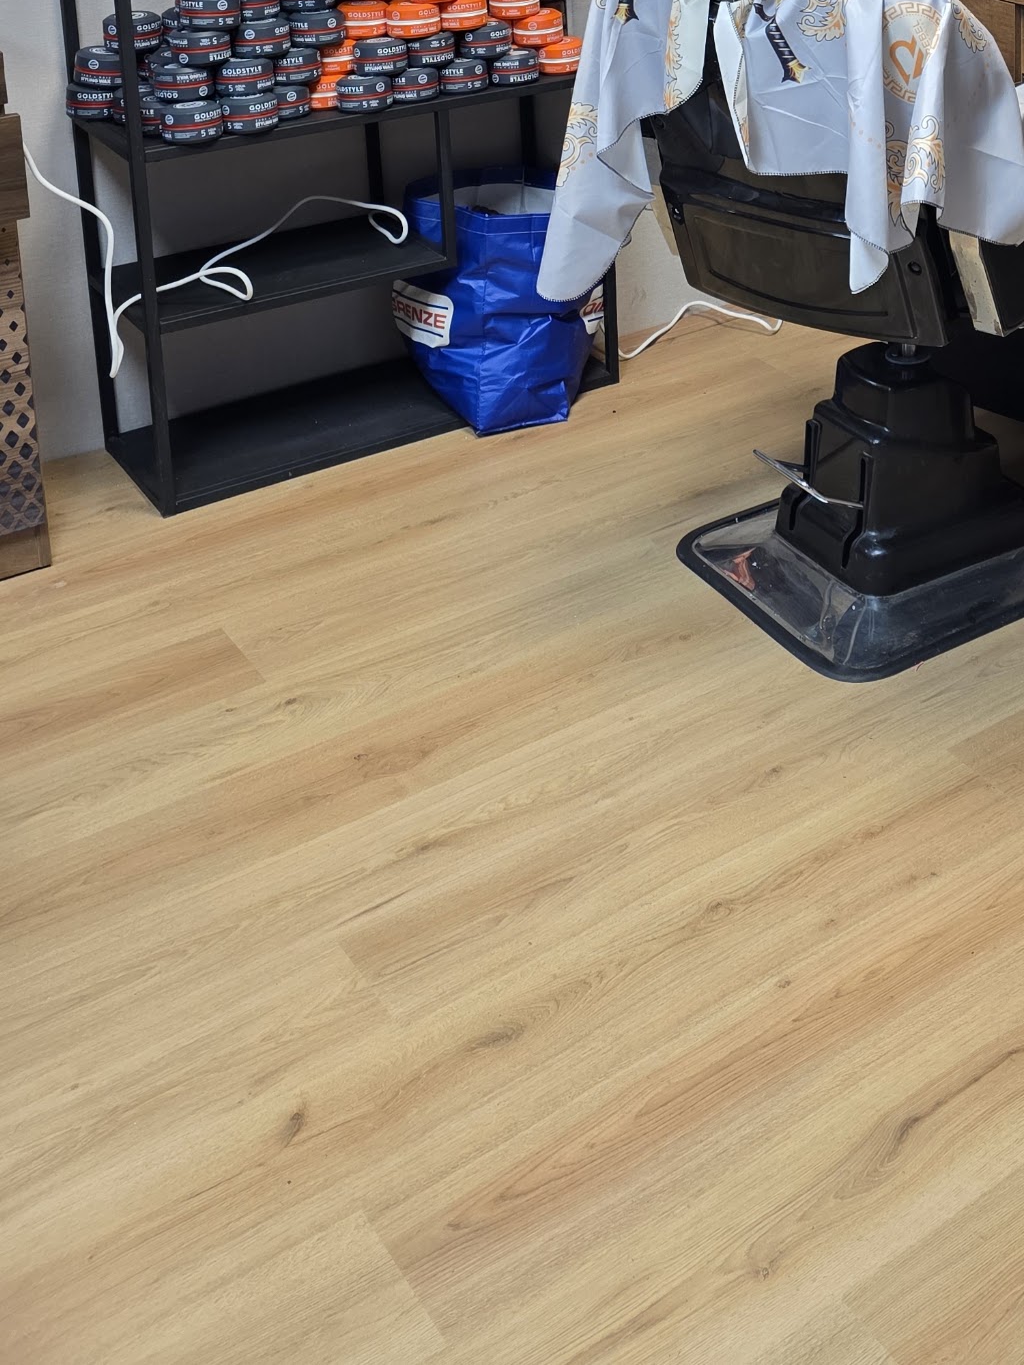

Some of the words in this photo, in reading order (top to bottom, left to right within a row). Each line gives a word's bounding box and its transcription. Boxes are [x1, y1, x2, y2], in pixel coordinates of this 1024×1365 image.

[222, 66, 262, 74] GOLDSTYLE
[314, 69, 318, 77] 5
[468, 81, 473, 89] 5
[201, 129, 206, 137] 5
